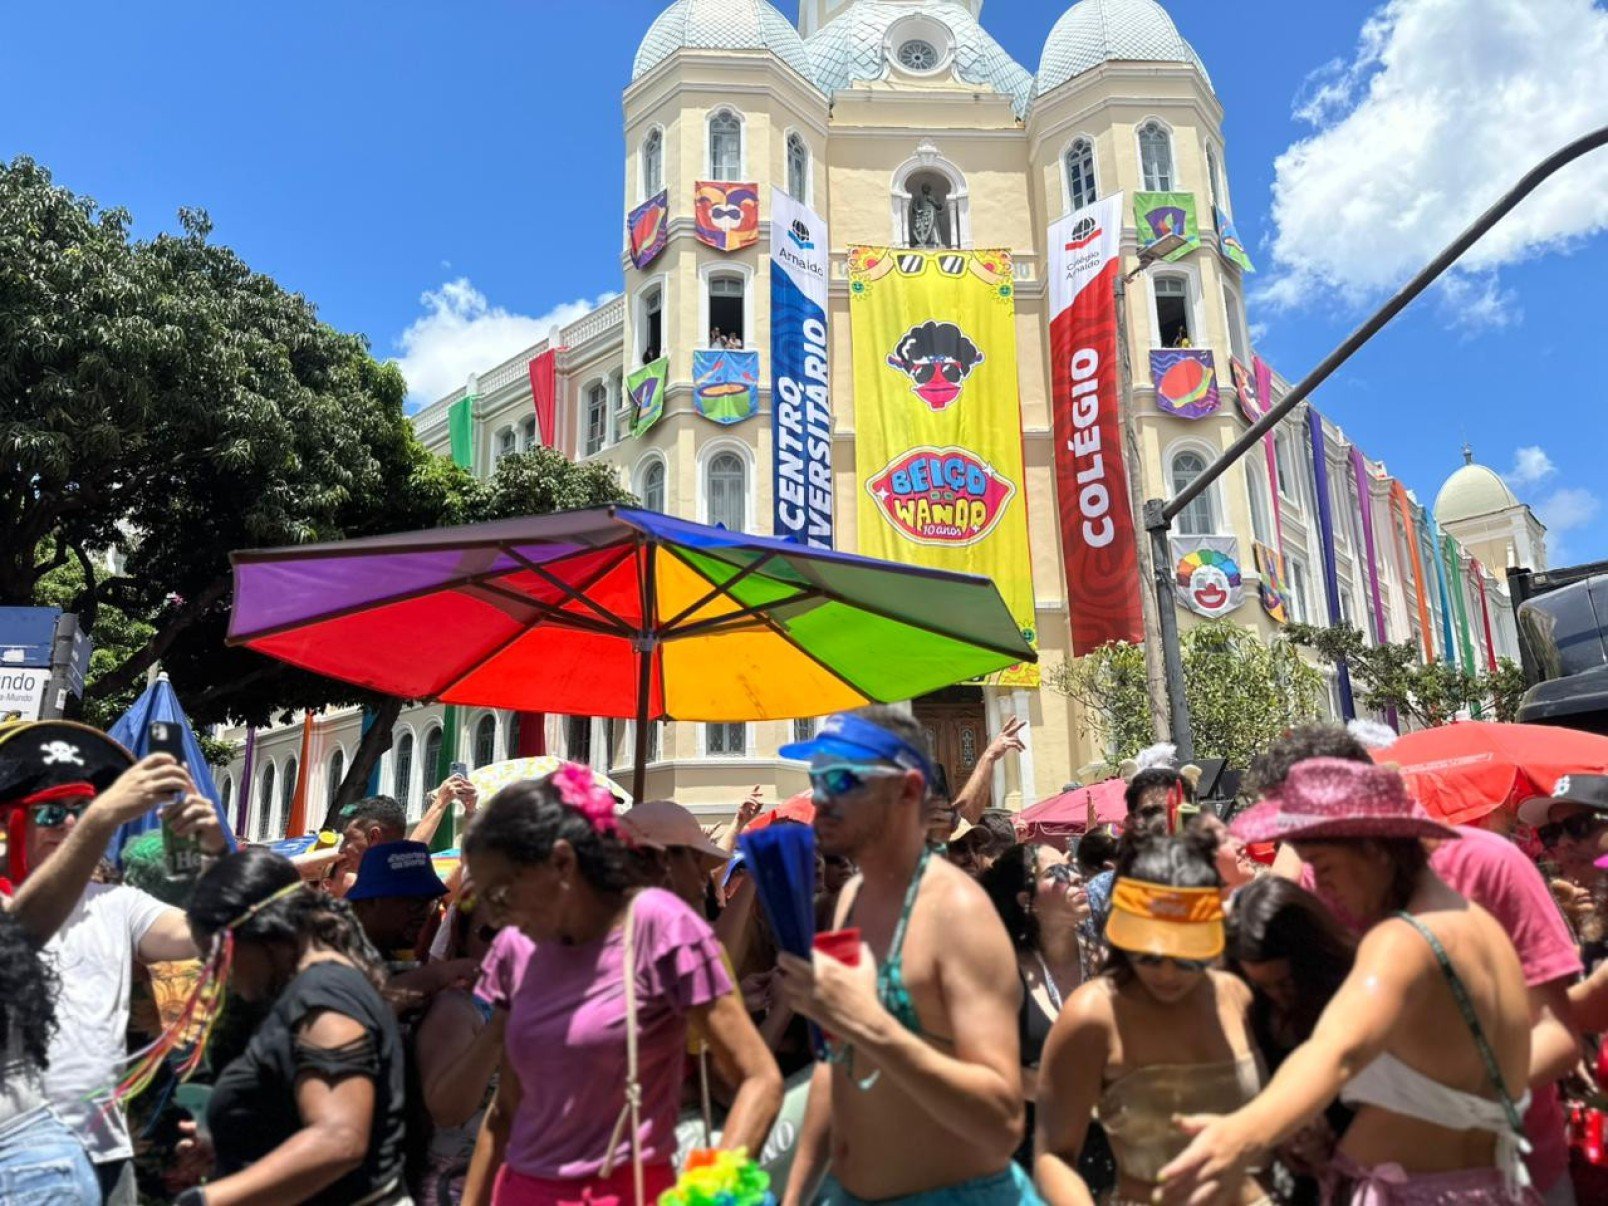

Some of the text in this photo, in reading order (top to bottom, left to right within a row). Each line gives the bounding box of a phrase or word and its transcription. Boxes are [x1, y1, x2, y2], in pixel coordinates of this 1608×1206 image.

[779, 247, 824, 276] Arnaldo
[1066, 259, 1100, 280] Arnaldo
[778, 376, 806, 531] CENTRO
[1068, 347, 1114, 548] COLÉGIO
[922, 524, 962, 536] 10 anos
[0, 672, 36, 691] ndo
